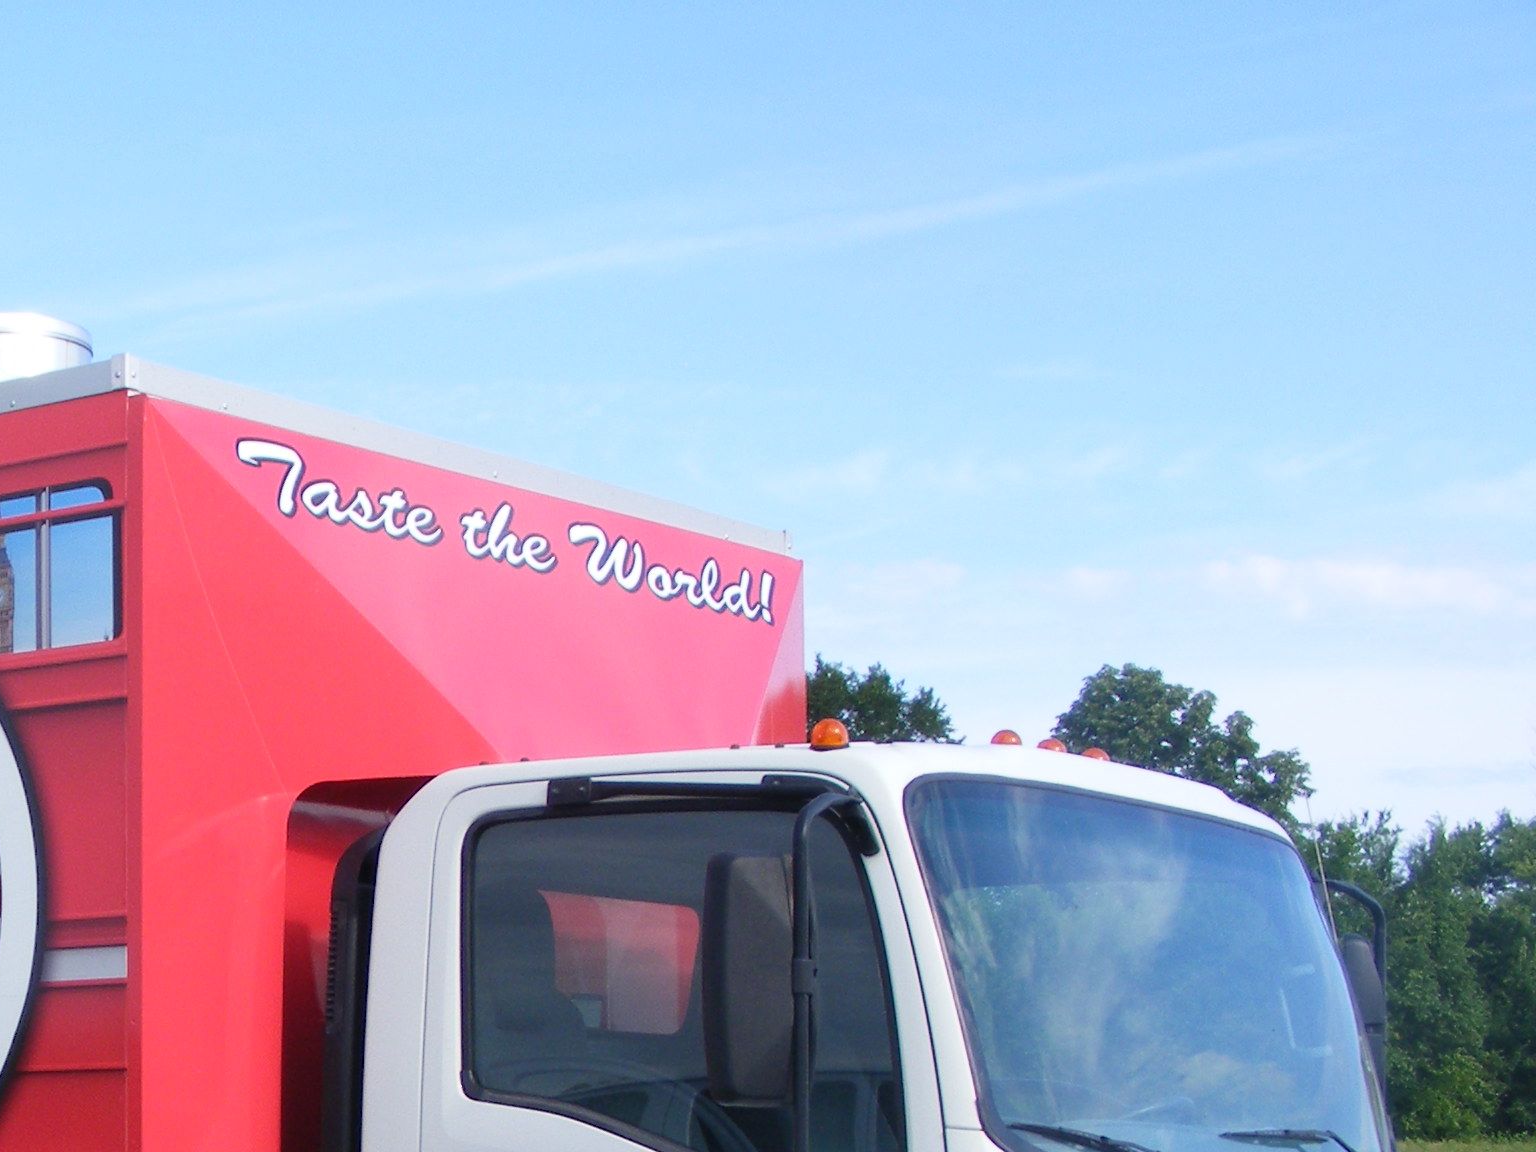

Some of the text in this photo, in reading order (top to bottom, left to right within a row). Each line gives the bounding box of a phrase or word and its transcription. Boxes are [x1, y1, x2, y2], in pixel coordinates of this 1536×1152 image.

[236, 437, 775, 625] Taste the World!
